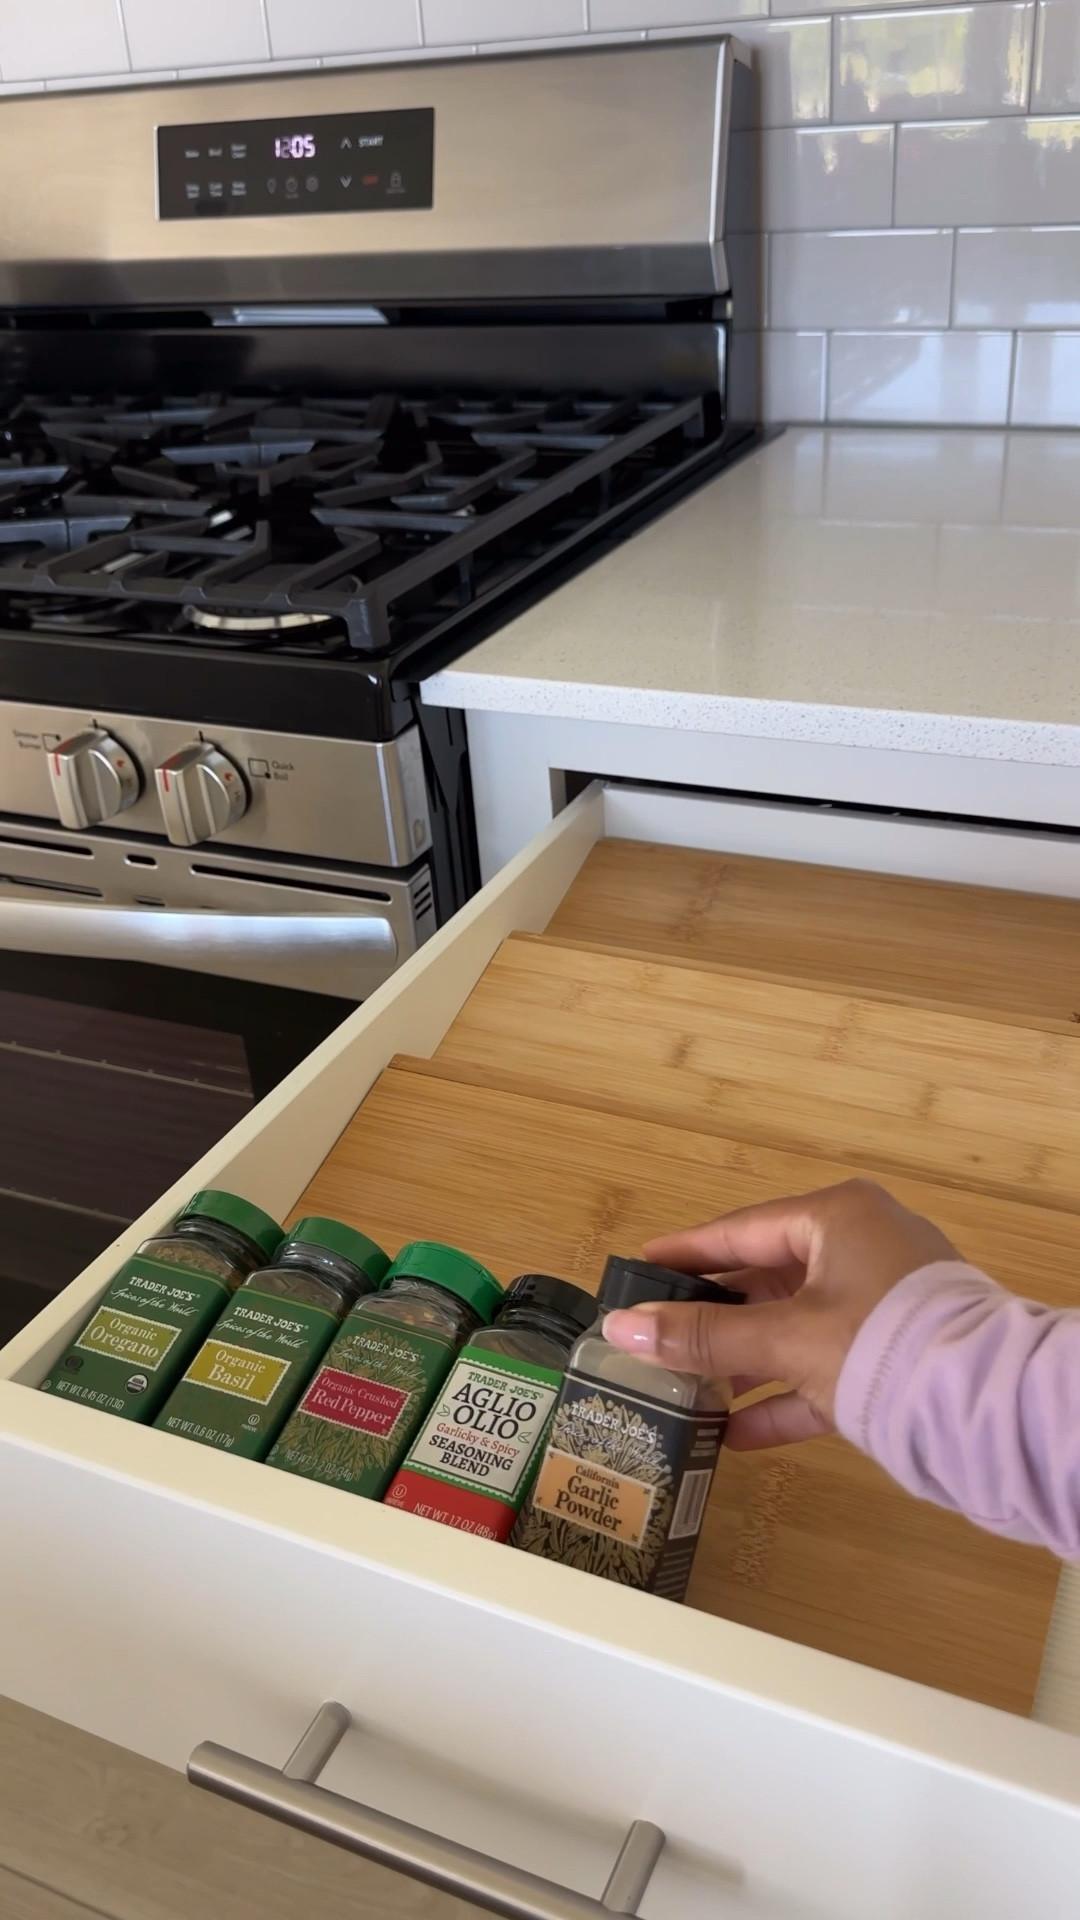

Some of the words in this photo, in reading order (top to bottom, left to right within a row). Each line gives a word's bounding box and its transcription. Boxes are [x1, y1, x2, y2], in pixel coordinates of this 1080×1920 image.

[129, 1276, 165, 1295] TRADER
[167, 1288, 196, 1302] JOE'S
[109, 1318, 158, 1341] Organic
[233, 1306, 273, 1324] TRADER
[273, 1318, 304, 1333] JOE'S
[90, 1325, 159, 1358] Oregano
[352, 1336, 389, 1354] TRADER
[389, 1347, 419, 1362] JOE'S
[215, 1349, 266, 1373] Organic
[208, 1364, 255, 1391] Basil
[467, 1372, 508, 1391] TRADER
[509, 1384, 540, 1401] JOE'S
[56, 1380, 71, 1391] NET
[96, 1394, 108, 1405] OZ
[311, 1388, 340, 1407] Red
[340, 1400, 391, 1425] Pepper
[321, 1377, 356, 1395] Organic
[357, 1388, 399, 1408] Crushed
[452, 1383, 537, 1422] AGLIO
[166, 1416, 184, 1428] NET
[192, 1424, 205, 1437] 0.6
[205, 1428, 218, 1442] OZ
[216, 1431, 235, 1448] (17g)
[453, 1405, 519, 1440] OLIO
[570, 1404, 619, 1431] TRADER
[620, 1424, 657, 1444] JOE'S
[429, 1435, 514, 1471] SEASONING
[436, 1423, 479, 1448] Garlicky
[480, 1437, 491, 1447] &
[491, 1440, 520, 1458] Spicy
[285, 1449, 300, 1461] NET
[325, 1463, 336, 1473] OZ
[440, 1452, 490, 1477] BLEND
[575, 1463, 620, 1490] California
[567, 1475, 619, 1510] Garlic
[413, 1502, 433, 1517] NET
[460, 1519, 475, 1531] OZ
[555, 1488, 622, 1532] Powder
